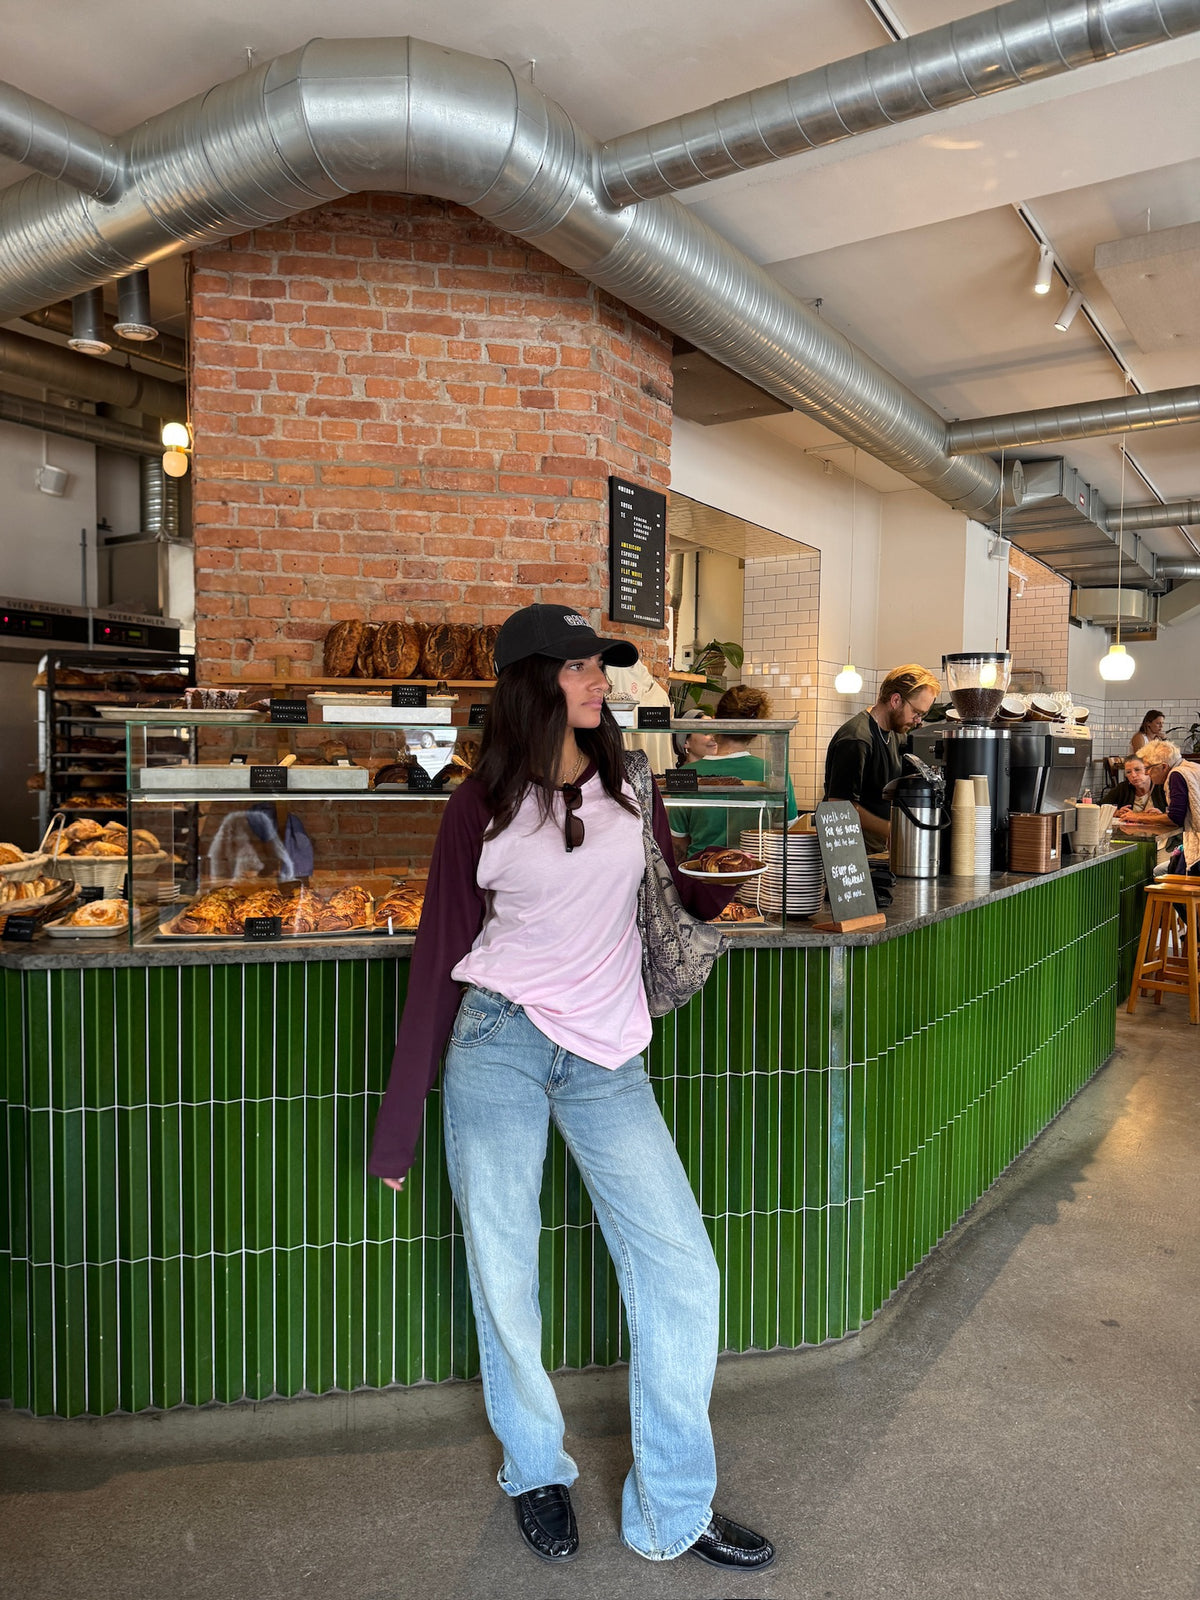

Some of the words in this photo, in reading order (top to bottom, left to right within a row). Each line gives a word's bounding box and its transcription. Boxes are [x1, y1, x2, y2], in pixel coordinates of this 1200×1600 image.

[620, 568, 630, 576] FLAT
[620, 594, 632, 602] LATTE
[6, 600, 34, 610] SVEBA
[38, 604, 72, 615] DAHLEN
[108, 613, 132, 621] SVEBA
[136, 616, 166, 626] DAHLEN
